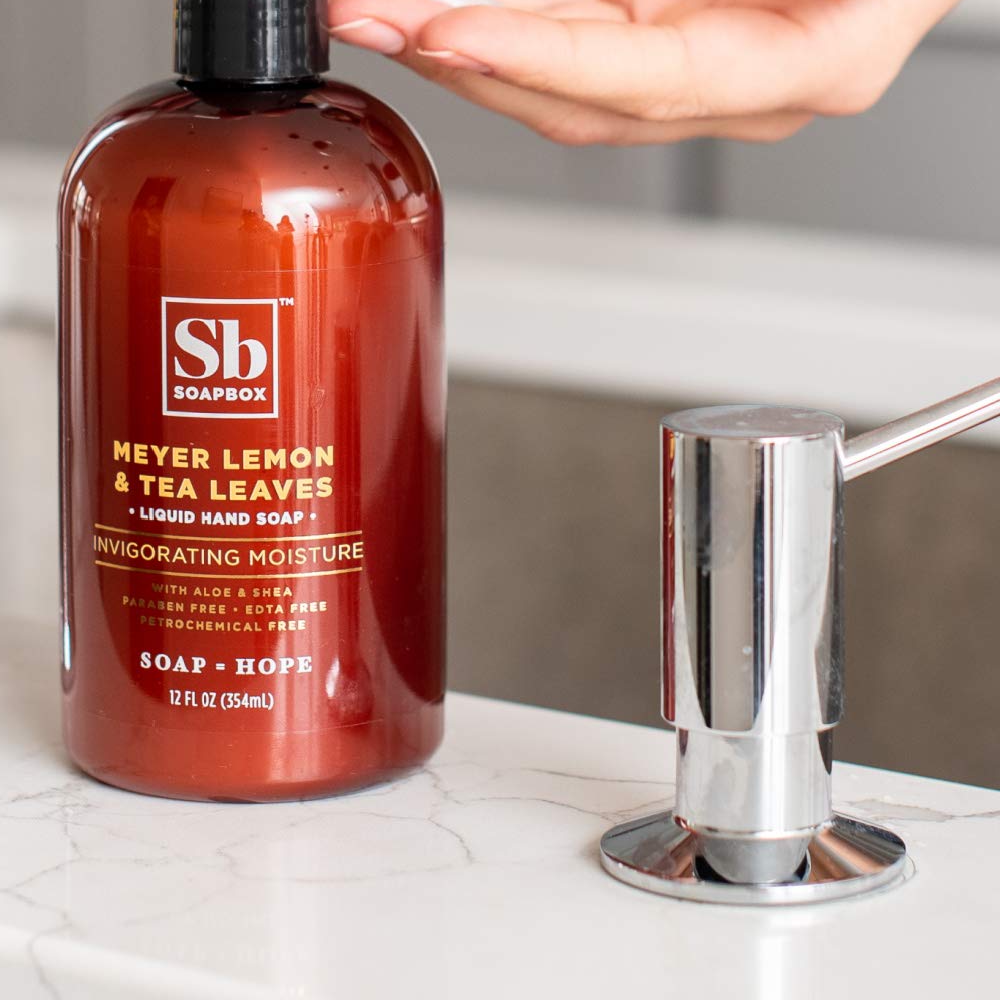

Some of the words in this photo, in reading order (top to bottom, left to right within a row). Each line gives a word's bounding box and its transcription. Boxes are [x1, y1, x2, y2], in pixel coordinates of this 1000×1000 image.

[174, 318, 267, 380] Sb
[173, 386, 267, 402] SOAPBOX
[113, 440, 209, 470] MEYER
[223, 445, 334, 470] LEMON
[114, 471, 129, 493] &
[139, 474, 198, 500] TEA
[210, 476, 333, 501] LEAVES
[139, 506, 196, 525] LIQUID
[201, 511, 250, 526] HAND
[256, 510, 304, 526] SOAP
[93, 534, 240, 566] INVIGORATING
[250, 541, 364, 566] MOISTURE
[151, 582, 188, 596] WITH
[193, 586, 232, 598] ALOE
[237, 587, 247, 598] &
[252, 586, 293, 598] SHEA
[122, 595, 185, 613] PARABEN
[190, 603, 227, 615] FREE
[245, 604, 285, 615] EDTA
[290, 601, 328, 614] FREE
[139, 615, 263, 633] PETROCHEMICAL
[268, 619, 307, 632] FREE
[140, 651, 207, 674] SOAP
[235, 655, 313, 676] HOPE
[168, 689, 182, 706] 12
[184, 690, 198, 707] FL
[201, 691, 217, 708] OZ
[220, 692, 275, 710] (354mL)
